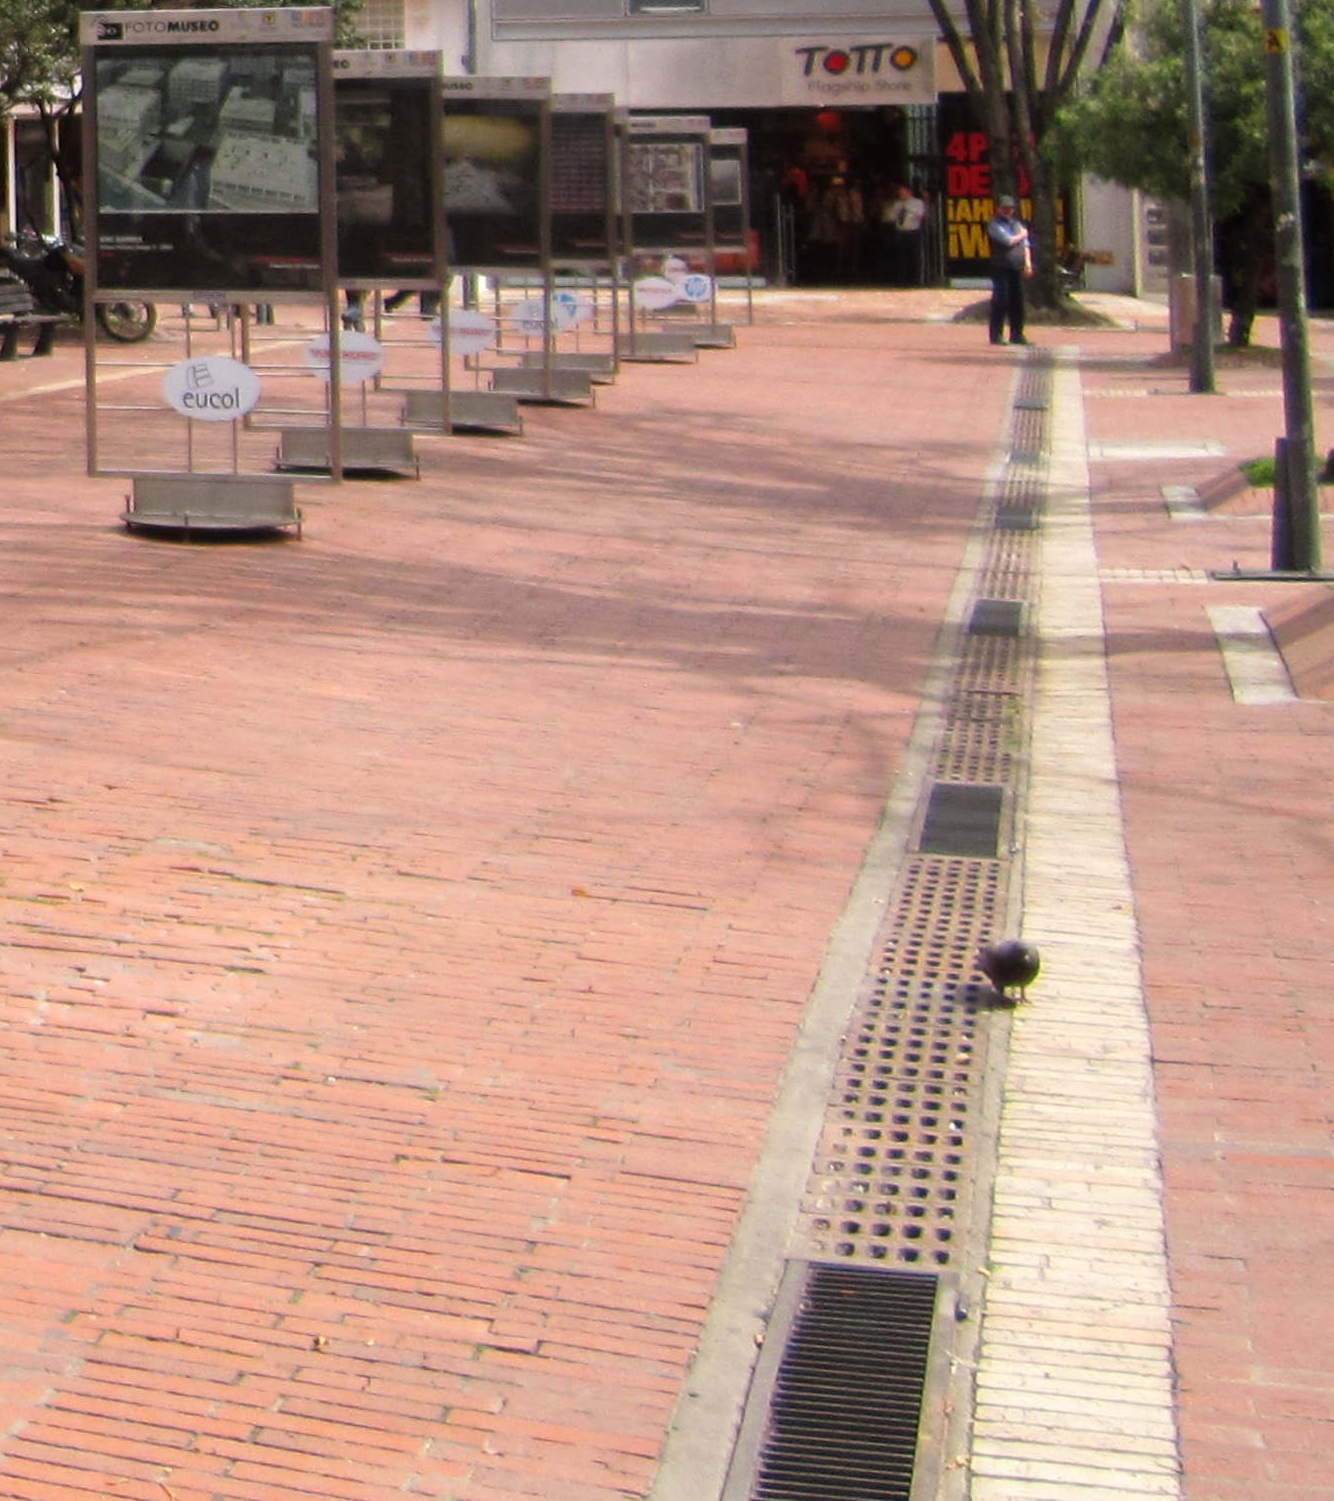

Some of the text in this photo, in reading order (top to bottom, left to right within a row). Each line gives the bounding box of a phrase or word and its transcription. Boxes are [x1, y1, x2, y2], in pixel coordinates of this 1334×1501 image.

[125, 19, 220, 33] FOTOMUSEO
[795, 42, 918, 75] TOTTO
[875, 80, 912, 91] Store
[183, 387, 240, 409] eucol
